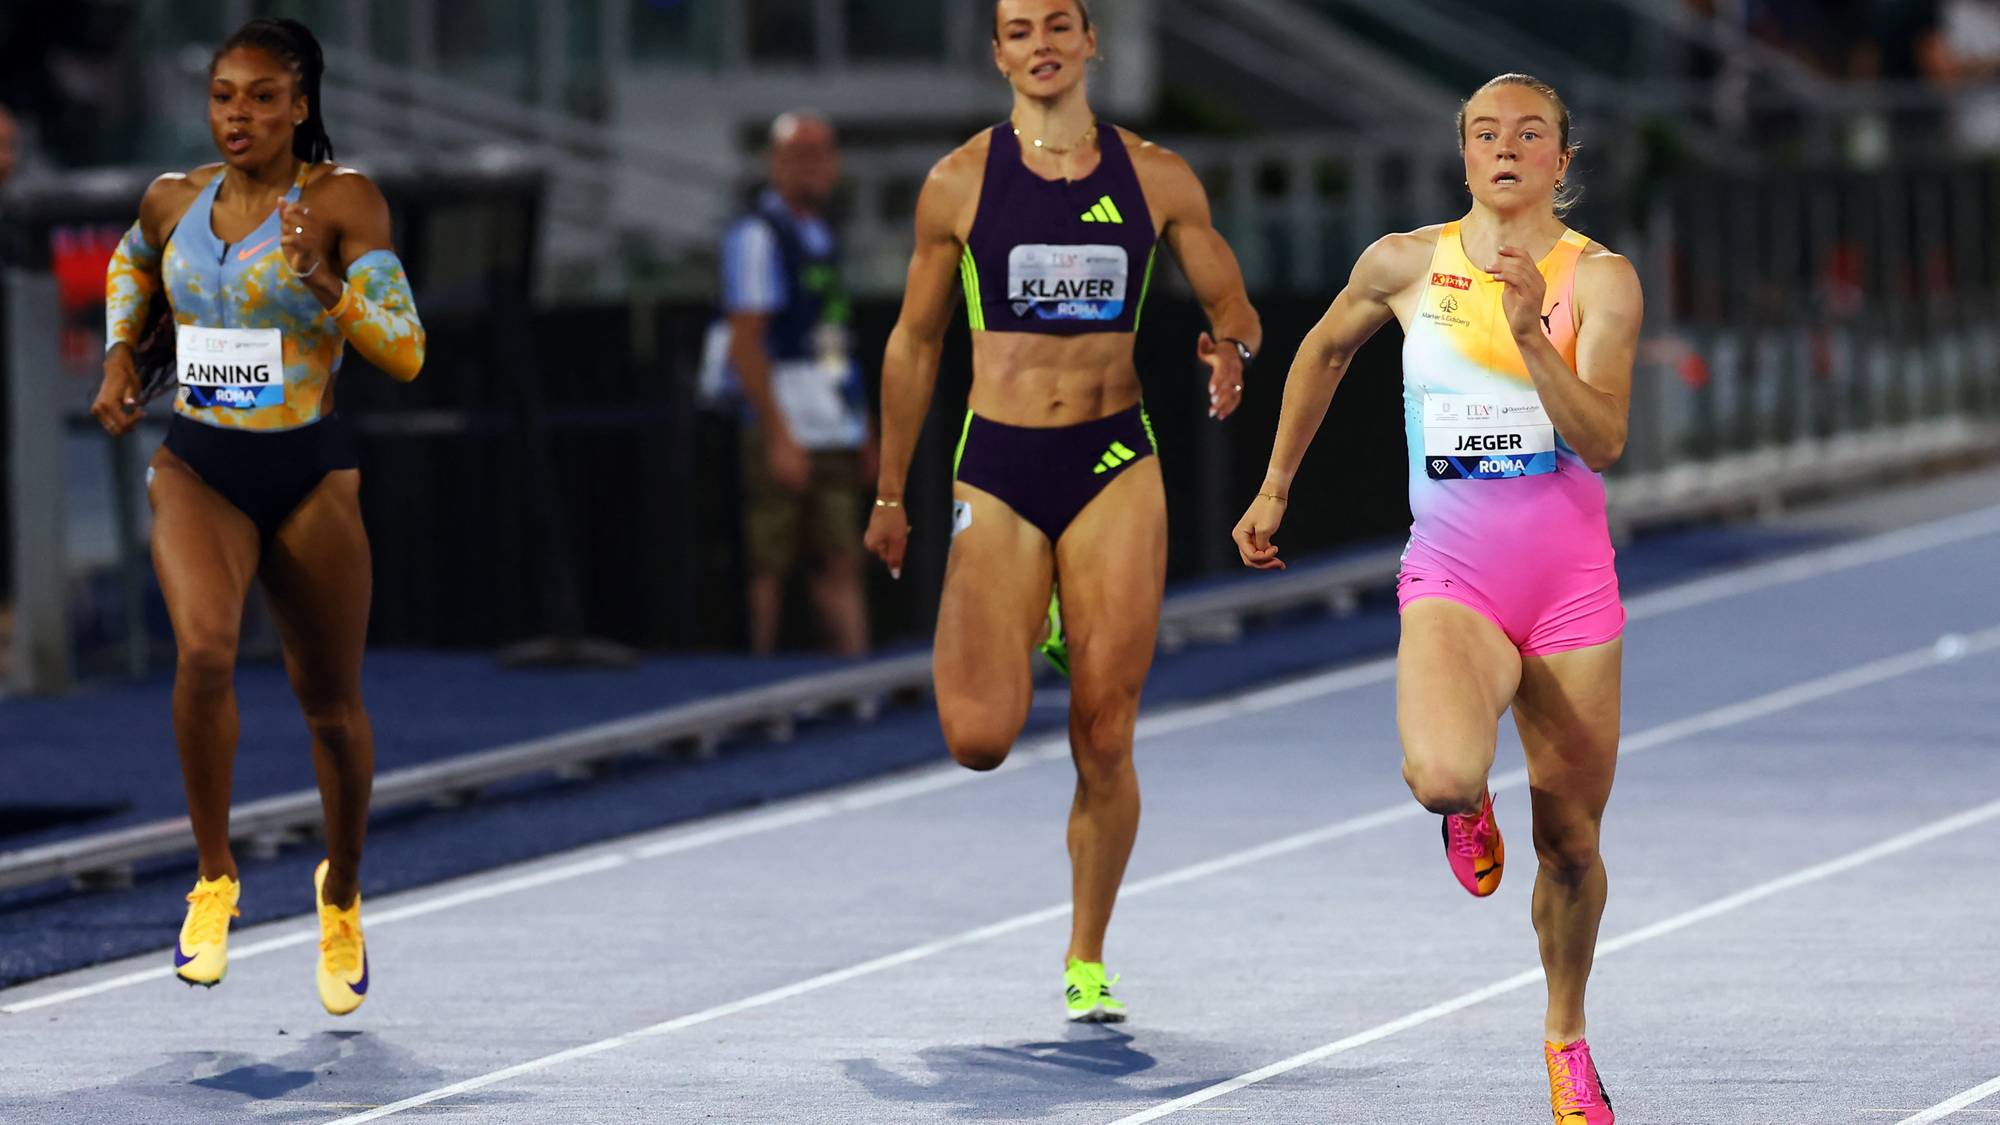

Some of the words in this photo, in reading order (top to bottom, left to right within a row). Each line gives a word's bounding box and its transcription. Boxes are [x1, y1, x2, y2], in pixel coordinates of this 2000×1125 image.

[1022, 279, 1114, 298] KLAVER
[1057, 302, 1099, 316] ROMA
[186, 363, 269, 383] ANNING
[216, 389, 256, 403] ROMA
[1466, 404, 1489, 416] ITA
[1455, 434, 1522, 451] JÆGER
[1480, 460, 1526, 473] ROMA
